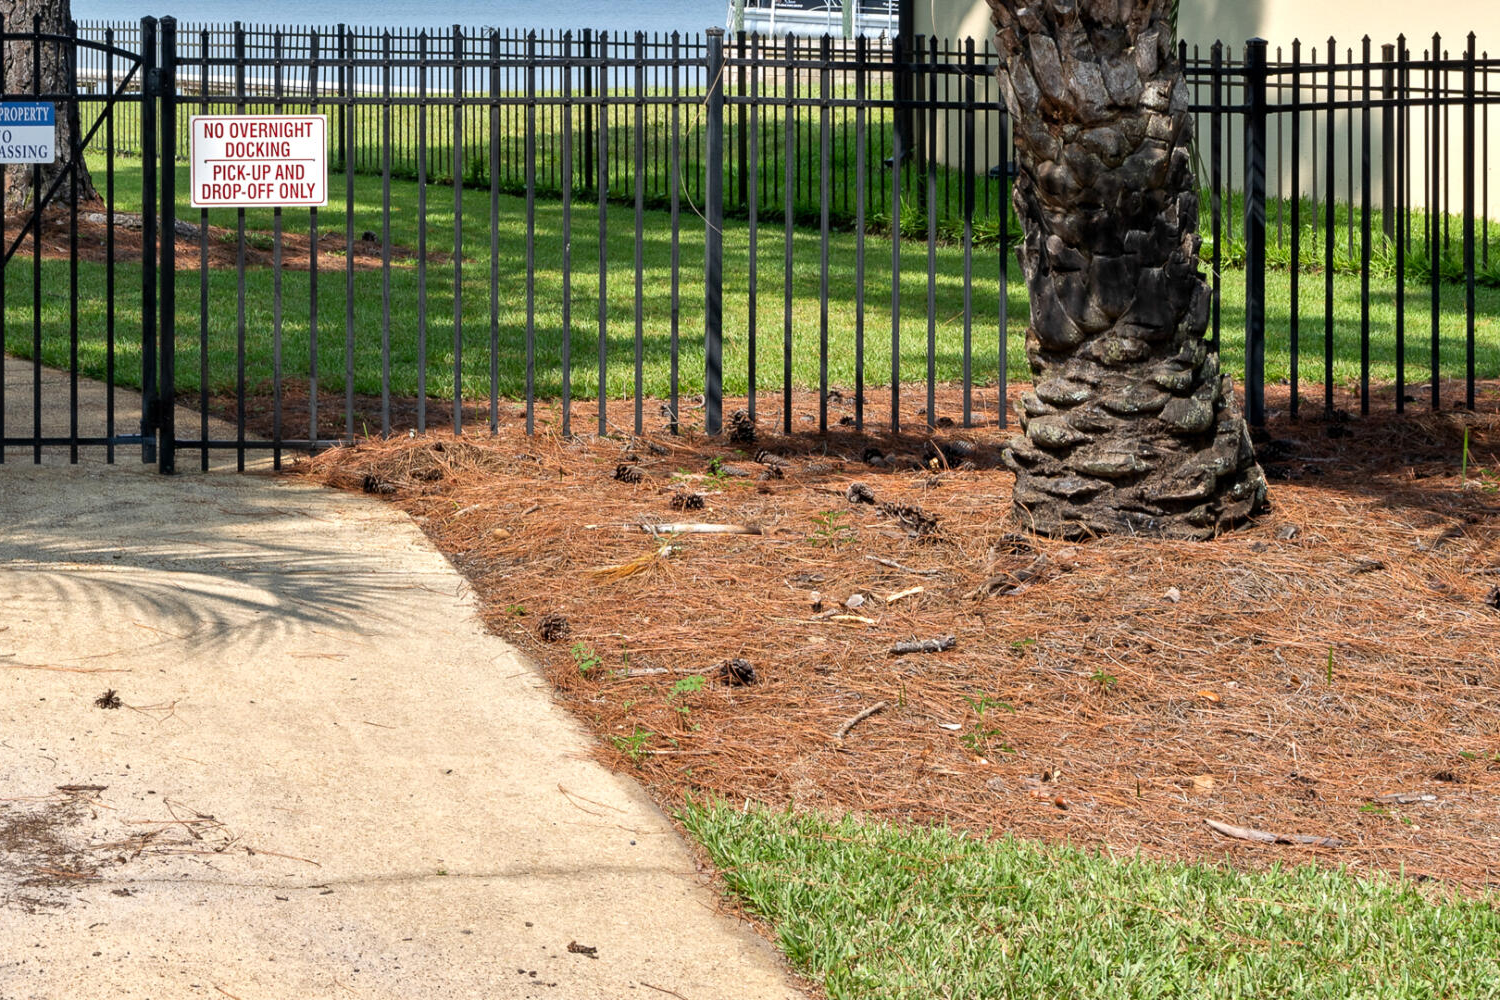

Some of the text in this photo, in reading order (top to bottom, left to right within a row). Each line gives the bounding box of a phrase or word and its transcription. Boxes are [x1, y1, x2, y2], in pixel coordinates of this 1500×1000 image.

[204, 122, 313, 139] NO OVERNIGHT
[225, 141, 291, 158] DOCKING
[213, 164, 305, 181] PICK-UP AND
[202, 182, 316, 200] DROP-OFF ONLY
